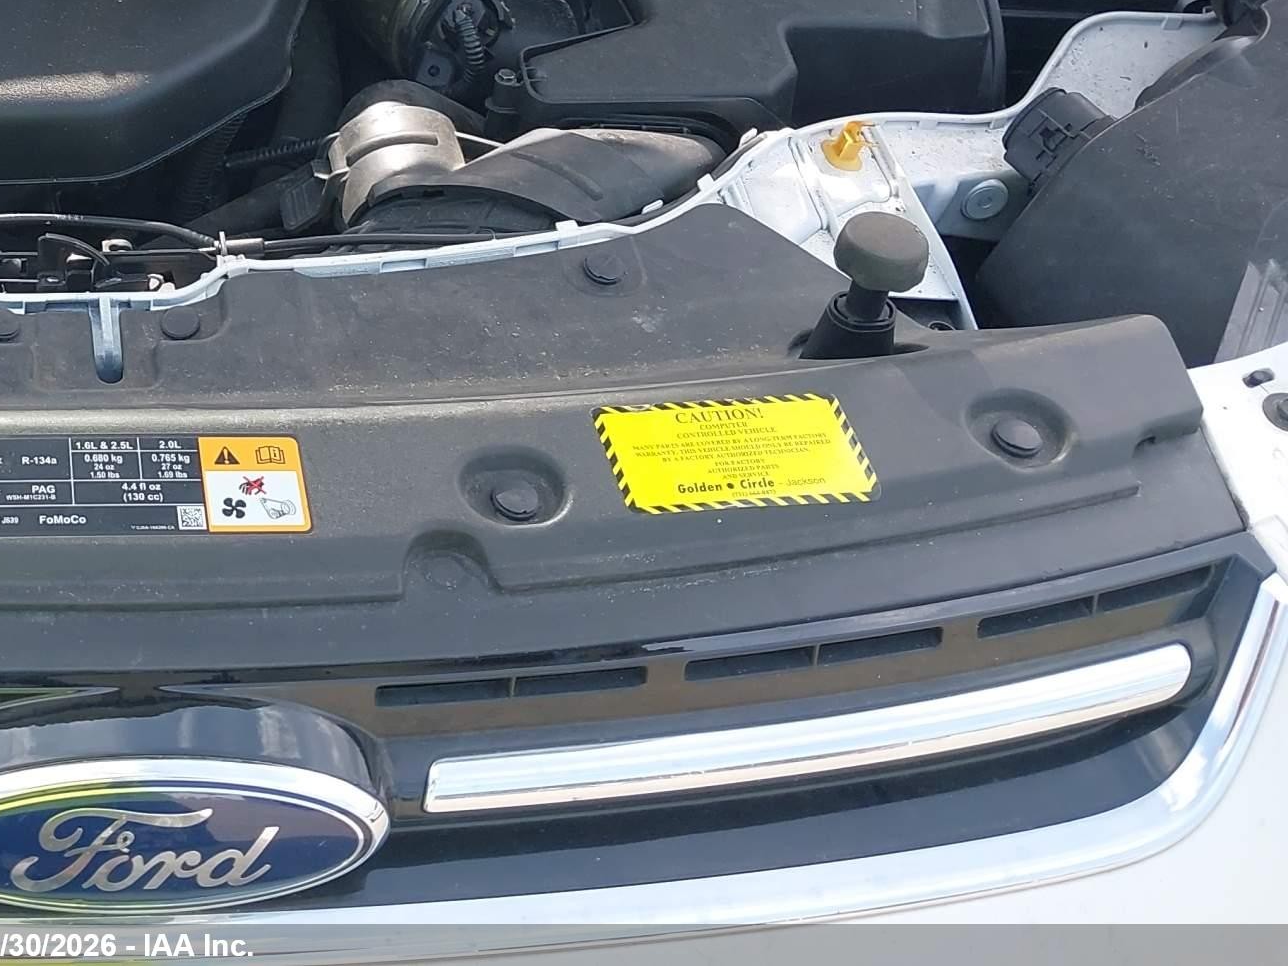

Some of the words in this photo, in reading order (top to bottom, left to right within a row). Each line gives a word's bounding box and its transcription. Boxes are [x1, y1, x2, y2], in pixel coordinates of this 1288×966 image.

[675, 407, 764, 424] CAUTION!
[699, 421, 748, 430] COMPUTER
[676, 429, 737, 440] CONTROLLED
[738, 427, 777, 436] VEHICLE
[75, 441, 98, 450] 1.6L
[100, 441, 109, 450] &
[111, 441, 133, 450] 2.5L
[159, 440, 181, 449] 2.0L
[656, 442, 679, 450] PARTS
[696, 439, 731, 447] COVERED
[731, 443, 760, 451] SHOULD
[795, 438, 831, 446] REPAIRED
[716, 450, 763, 459] AUTHORIZED
[21, 456, 58, 465] R-134a
[84, 454, 109, 463] 0.680
[111, 454, 123, 465] kg
[151, 454, 176, 463] 0.765
[178, 454, 191, 465] kg
[730, 458, 765, 466] FACTORY
[94, 463, 103, 471] 24
[161, 463, 171, 471] 27
[708, 465, 756, 474] AUTHORIZED
[90, 471, 105, 479] 1.50
[107, 471, 120, 479] lbs
[157, 471, 173, 479] 1.69
[175, 471, 188, 479] lbs
[31, 485, 56, 494] PAG
[122, 483, 137, 491] 4.4
[139, 483, 147, 491] fl
[678, 481, 723, 494] Golden
[740, 477, 775, 490] Circle
[785, 476, 826, 487] Jackson
[123, 493, 144, 503] (130
[146, 493, 163, 503] cc)
[39, 515, 87, 525] FoMoCo
[11, 807, 281, 892] Ford
